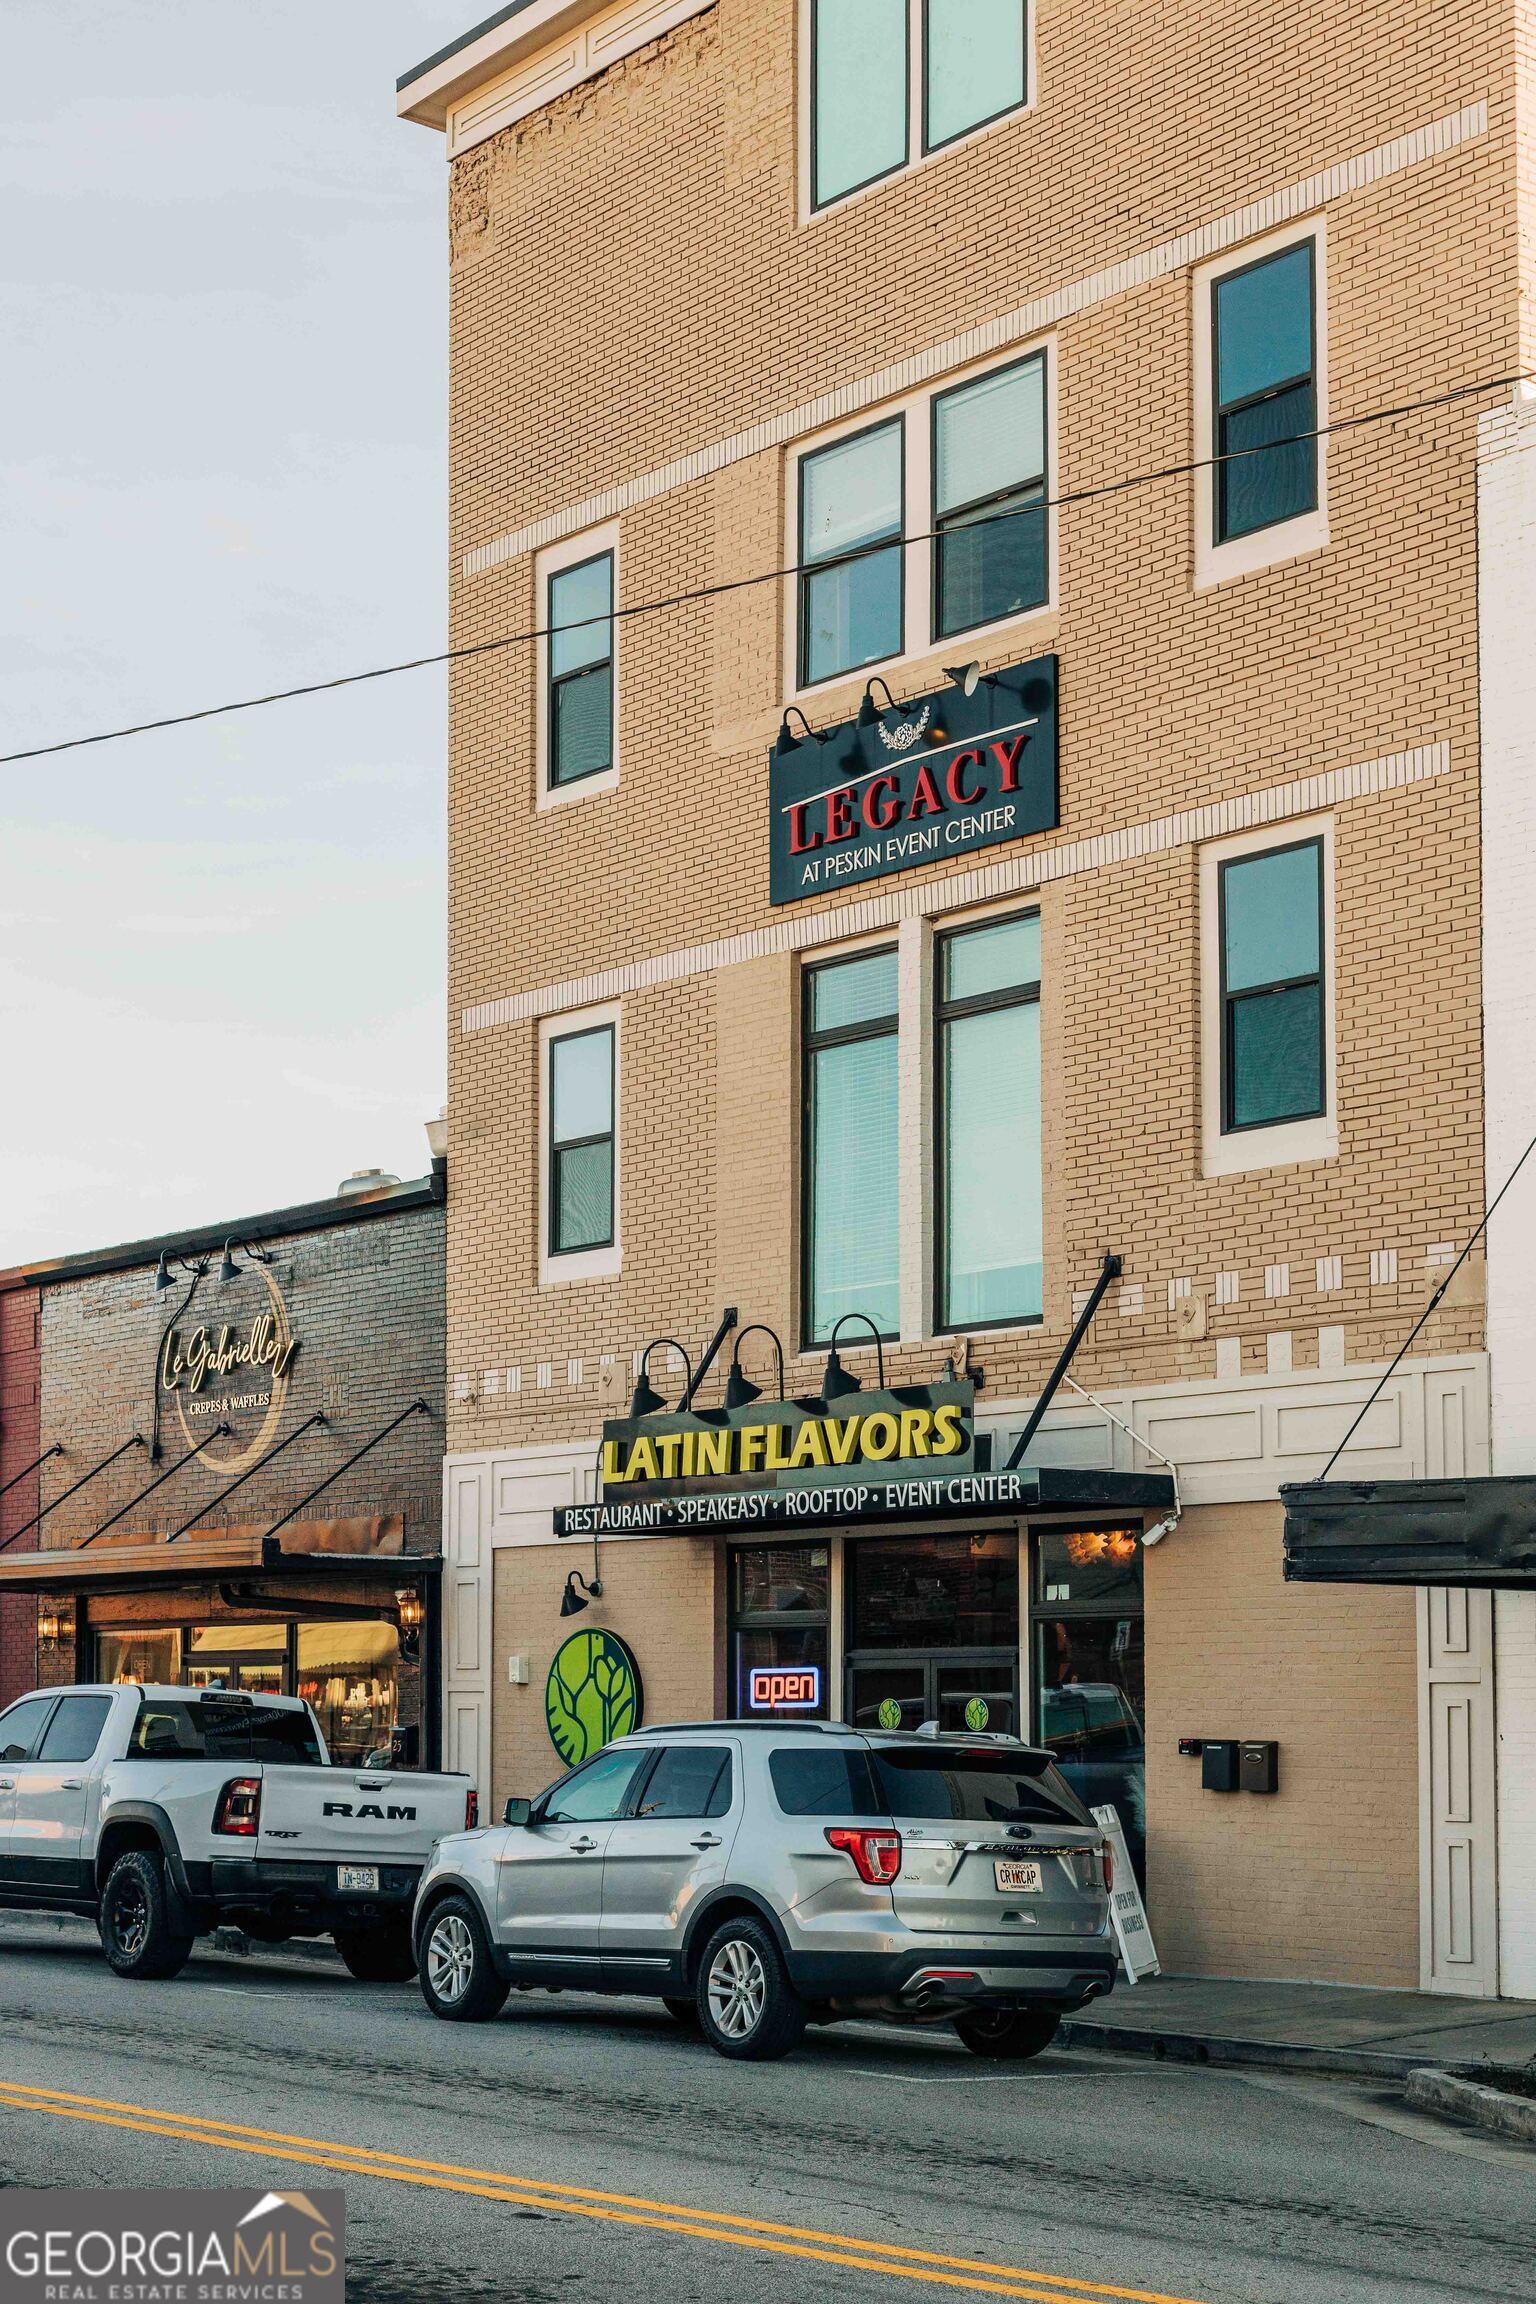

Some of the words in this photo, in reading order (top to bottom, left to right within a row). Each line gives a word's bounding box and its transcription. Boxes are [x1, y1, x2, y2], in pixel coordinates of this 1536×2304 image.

[788, 735, 1031, 855] LEGACY
[801, 861, 821, 885] AT
[825, 844, 881, 876] PESKIN
[886, 826, 941, 861] EVENT
[945, 805, 1016, 843] CENTER
[163, 1330, 183, 1390] Le
[190, 1399, 222, 1415] CREPES
[222, 1398, 229, 1411] &
[231, 1392, 270, 1409] WAFFLES
[603, 1429, 732, 1484] LATIN
[740, 1405, 963, 1471] FLAVORS
[565, 1502, 663, 1531] RESTAURANT
[677, 1495, 768, 1523] SPEAKEASY
[785, 1486, 868, 1516] ROOFTOP
[885, 1480, 943, 1508] EVENT
[947, 1474, 1021, 1504] CENTER
[755, 1676, 814, 1708] open
[323, 1802, 416, 1820] RAM
